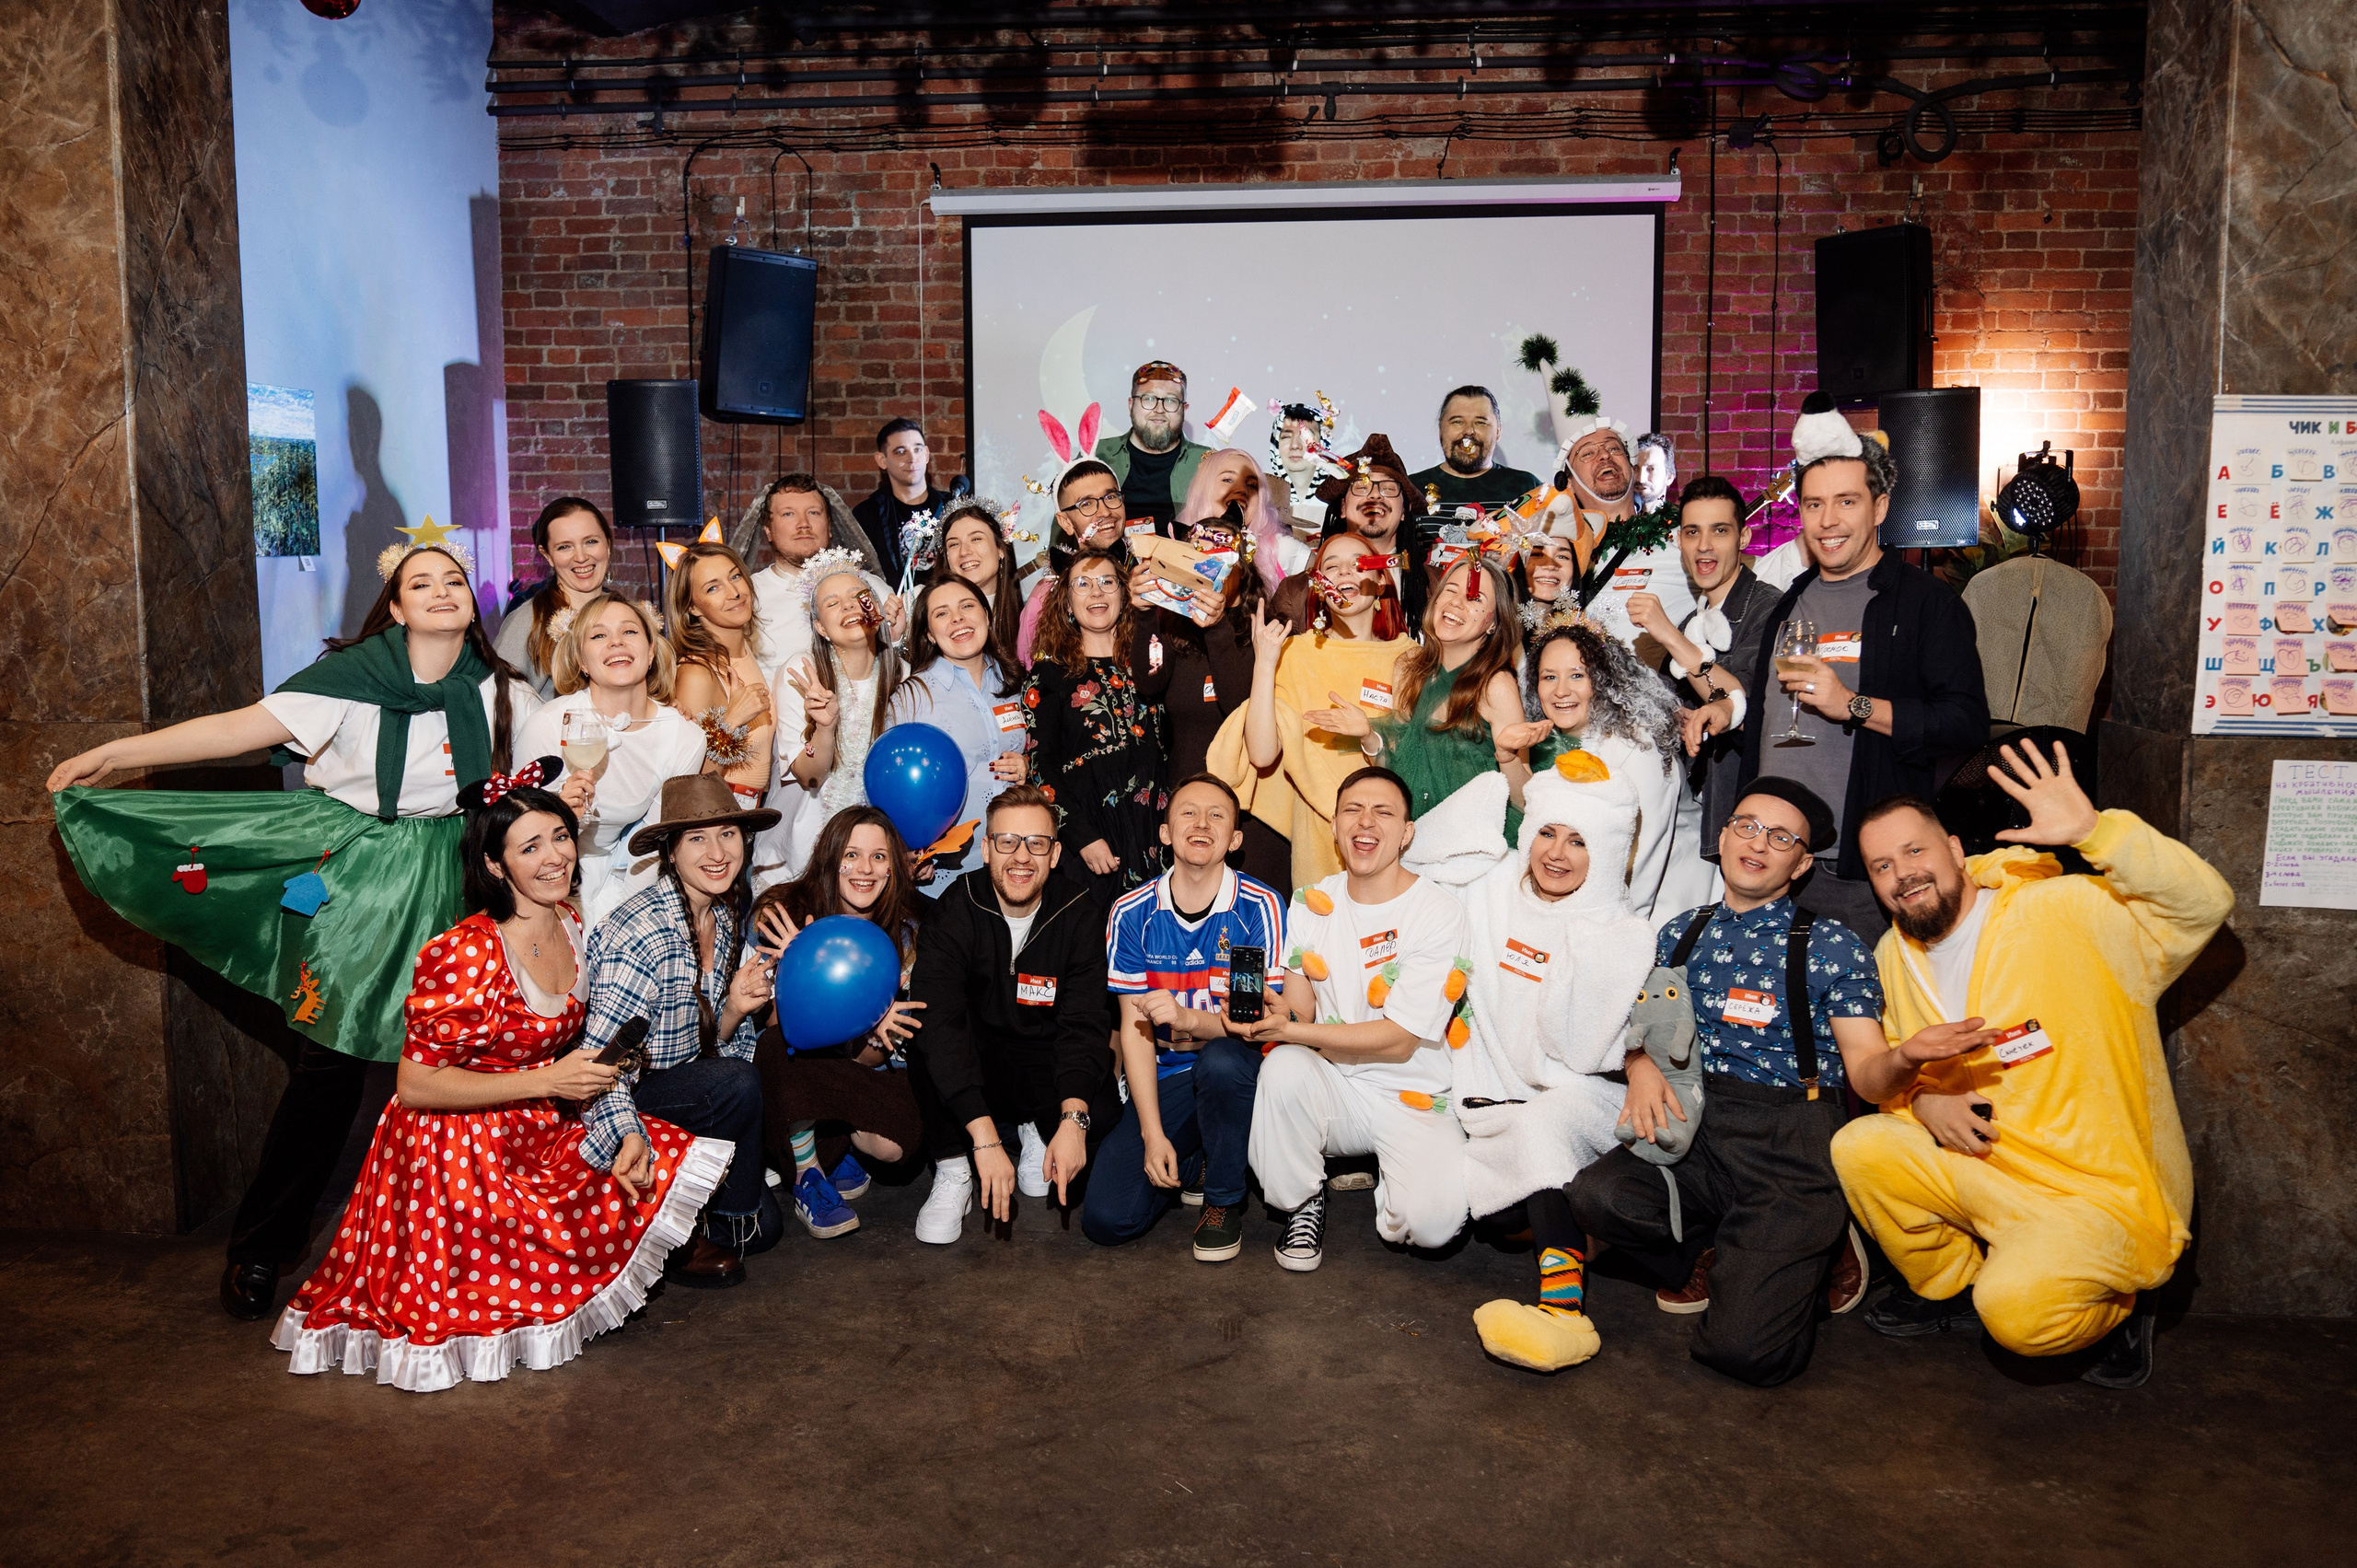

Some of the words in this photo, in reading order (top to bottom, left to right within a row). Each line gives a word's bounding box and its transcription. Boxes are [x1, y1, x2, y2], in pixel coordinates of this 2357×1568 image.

[2289, 421, 2321, 435] ЧИК
[2328, 421, 2340, 435] И
[2346, 421, 2357, 435] Б
[2218, 466, 2230, 480] А
[2271, 465, 2283, 478] Б
[2323, 465, 2335, 479] В
[2218, 505, 2227, 518] Е
[2270, 502, 2280, 518] Ё
[2315, 506, 2334, 519] Ж
[2212, 537, 2224, 554] Й
[2265, 541, 2278, 554] К
[2316, 542, 2329, 555] Л
[2209, 580, 2223, 594] О
[2264, 582, 2275, 595] П
[2315, 582, 2326, 596] Р
[2207, 617, 2223, 632] У
[2259, 617, 2272, 631] Ф
[2312, 618, 2325, 632] Х
[2205, 657, 2223, 670] Ш
[2259, 658, 2275, 674] Щ
[2306, 658, 2321, 672] Ъ
[2205, 695, 2215, 708] Э
[2252, 694, 2271, 707] Ю
[2307, 694, 2318, 708] Я
[2289, 764, 2350, 779] ТЕСТ
[1521, 947, 1534, 957] Имя
[2005, 1029, 2023, 1039] Имя
